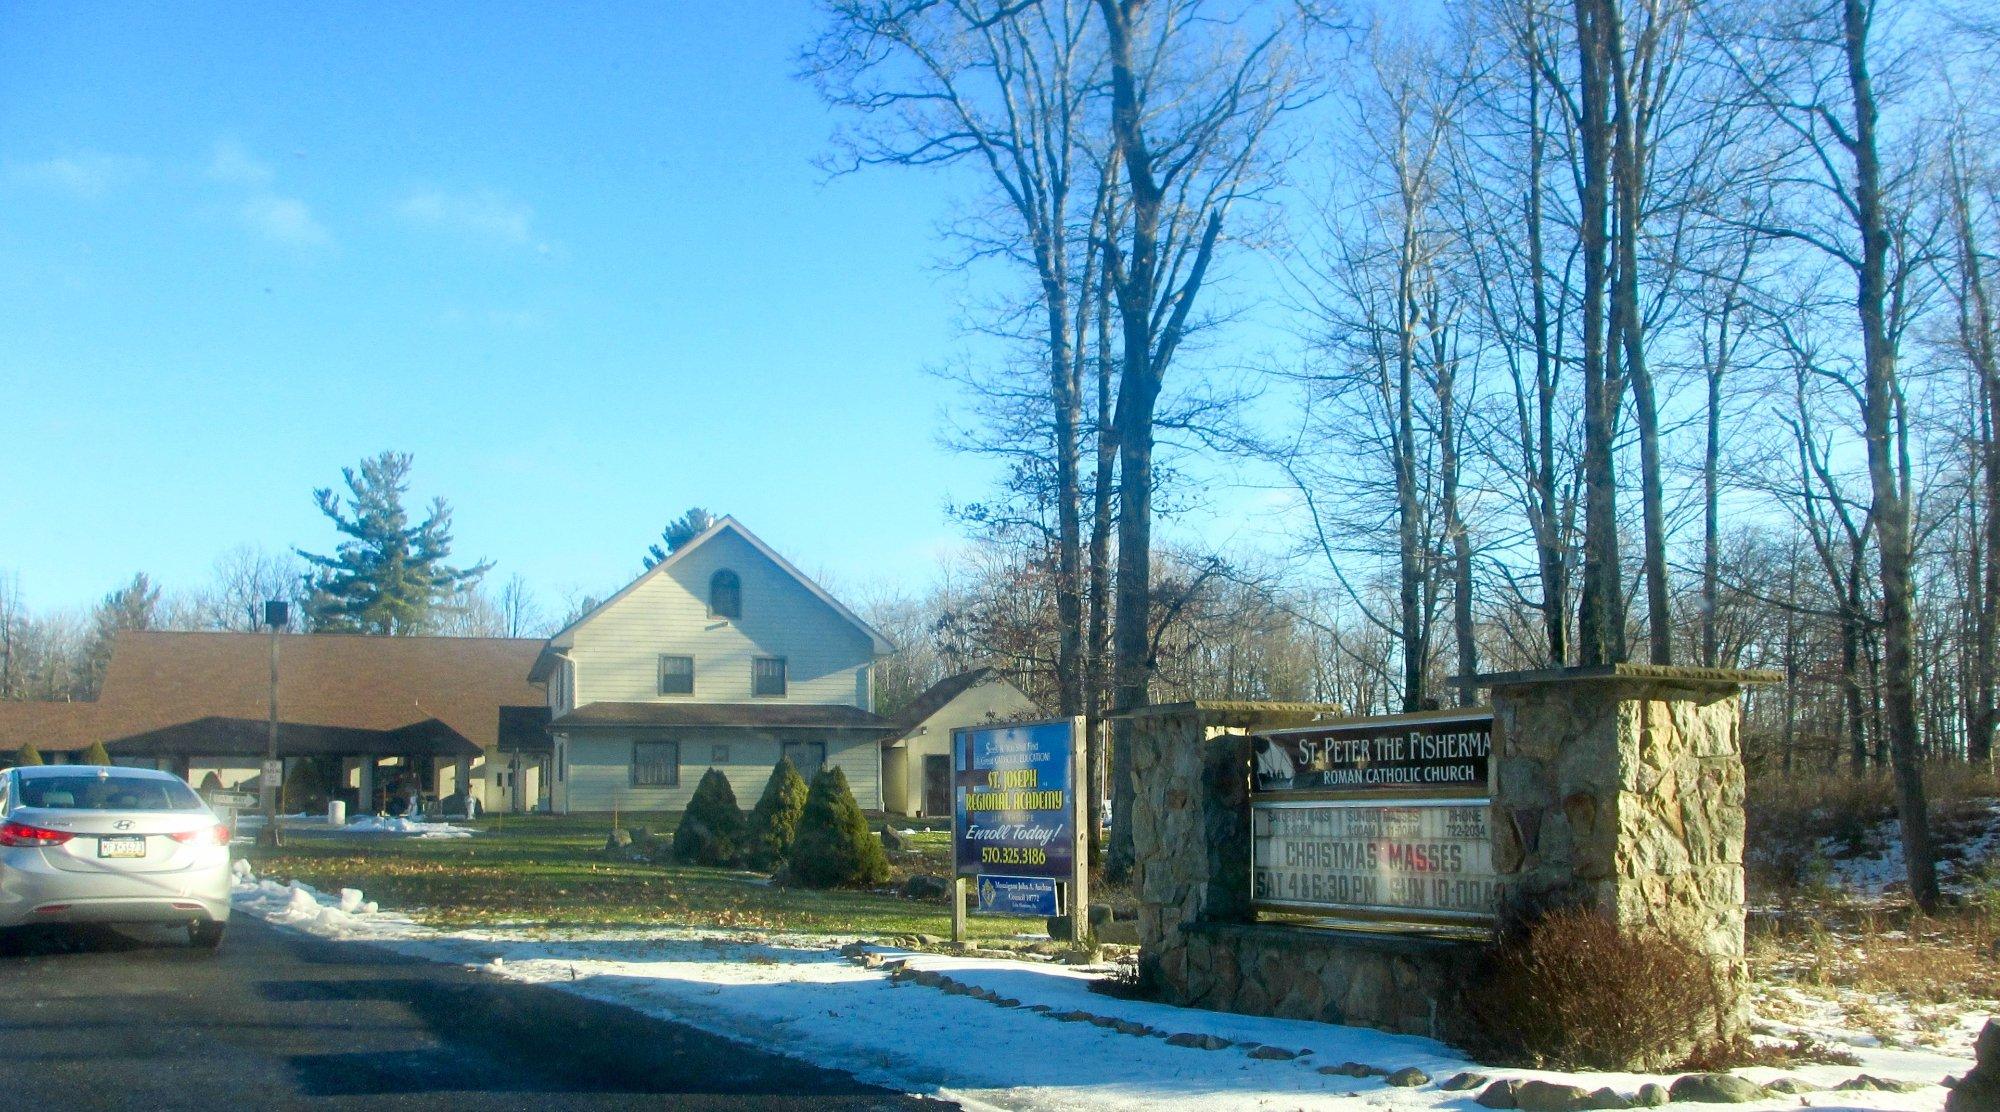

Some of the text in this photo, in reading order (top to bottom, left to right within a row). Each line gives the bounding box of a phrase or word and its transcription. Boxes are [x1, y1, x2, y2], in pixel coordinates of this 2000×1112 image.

[1324, 736, 1370, 763] PETER
[1374, 734, 1404, 761] THE
[1409, 731, 1491, 760] FISHERMA
[988, 769, 1038, 792] ST. JOSEPH
[1323, 764, 1475, 785] ROMAN CATHOLIC CHURCH
[965, 790, 1063, 811] REGIONAL ACADEMY
[1347, 809, 1378, 823] SUNDAY
[1383, 809, 1420, 823] MASSES
[1448, 808, 1482, 823] PHONE
[965, 823, 1064, 847] Enroll Today!
[1446, 823, 1486, 837] 722-2034
[981, 847, 1046, 865] 570.325.3186
[1285, 840, 1462, 874] CHRISTMAS MASSES
[1255, 871, 1284, 898] SAT
[1352, 875, 1377, 903] PM
[1389, 877, 1426, 907] SUN
[1432, 879, 1481, 908] 10:00
